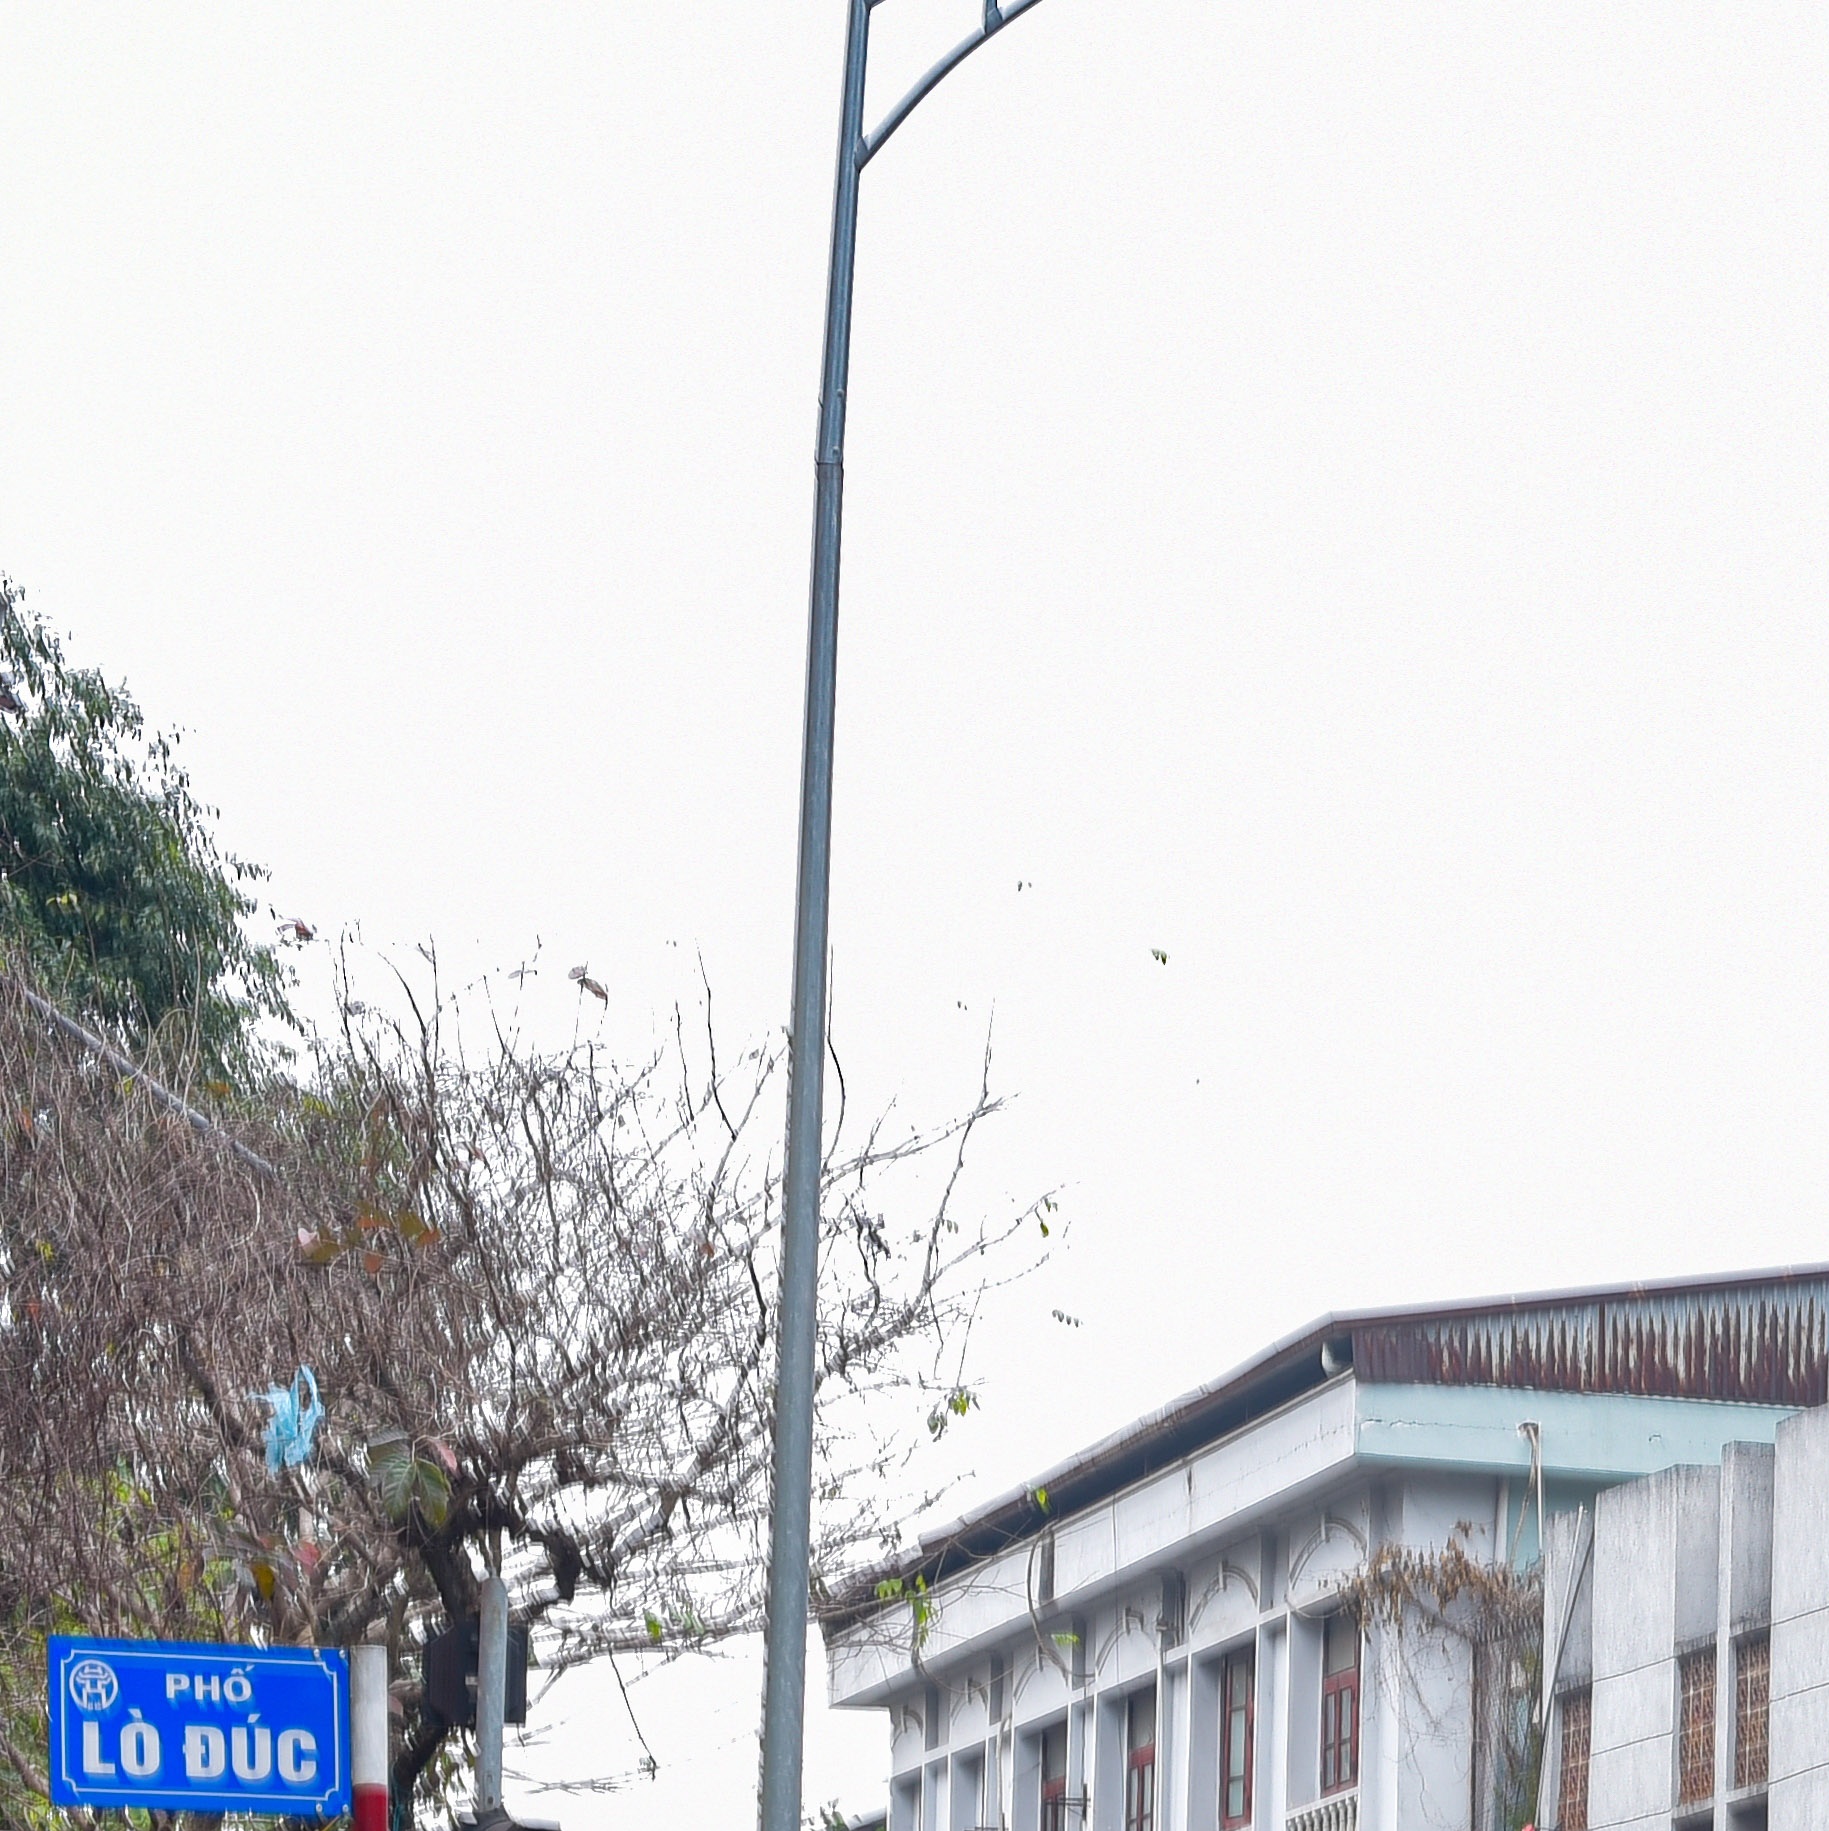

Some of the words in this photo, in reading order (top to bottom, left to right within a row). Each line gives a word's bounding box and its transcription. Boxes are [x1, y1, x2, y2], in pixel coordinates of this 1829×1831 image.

[166, 1665, 254, 1702] PHỐ
[82, 1708, 160, 1776] LÒ
[183, 1714, 317, 1782] ĐÚC
